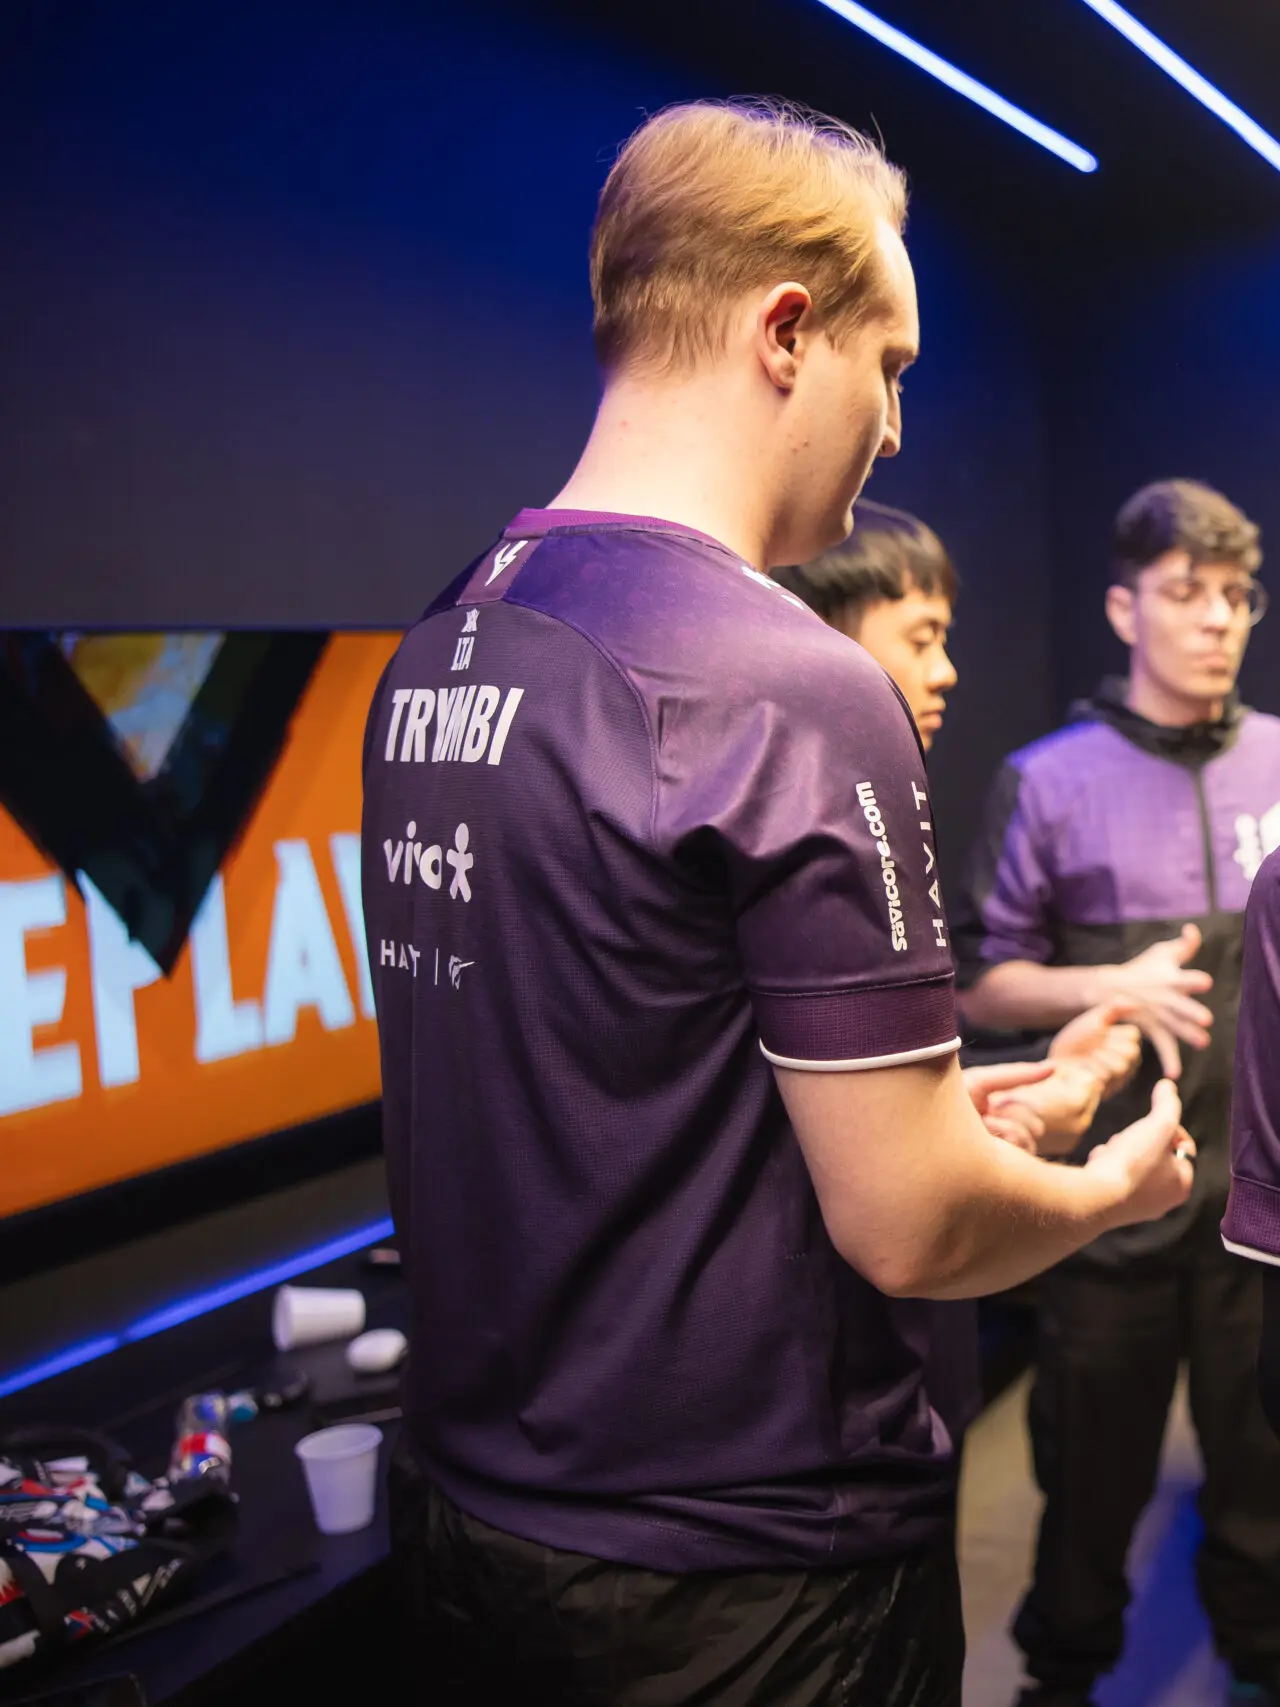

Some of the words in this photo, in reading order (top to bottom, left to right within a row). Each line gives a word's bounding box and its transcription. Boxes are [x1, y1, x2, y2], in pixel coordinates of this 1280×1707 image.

[451, 636, 475, 671] LTA
[384, 684, 525, 766] TRYMBI
[911, 780, 947, 947] HAVIT
